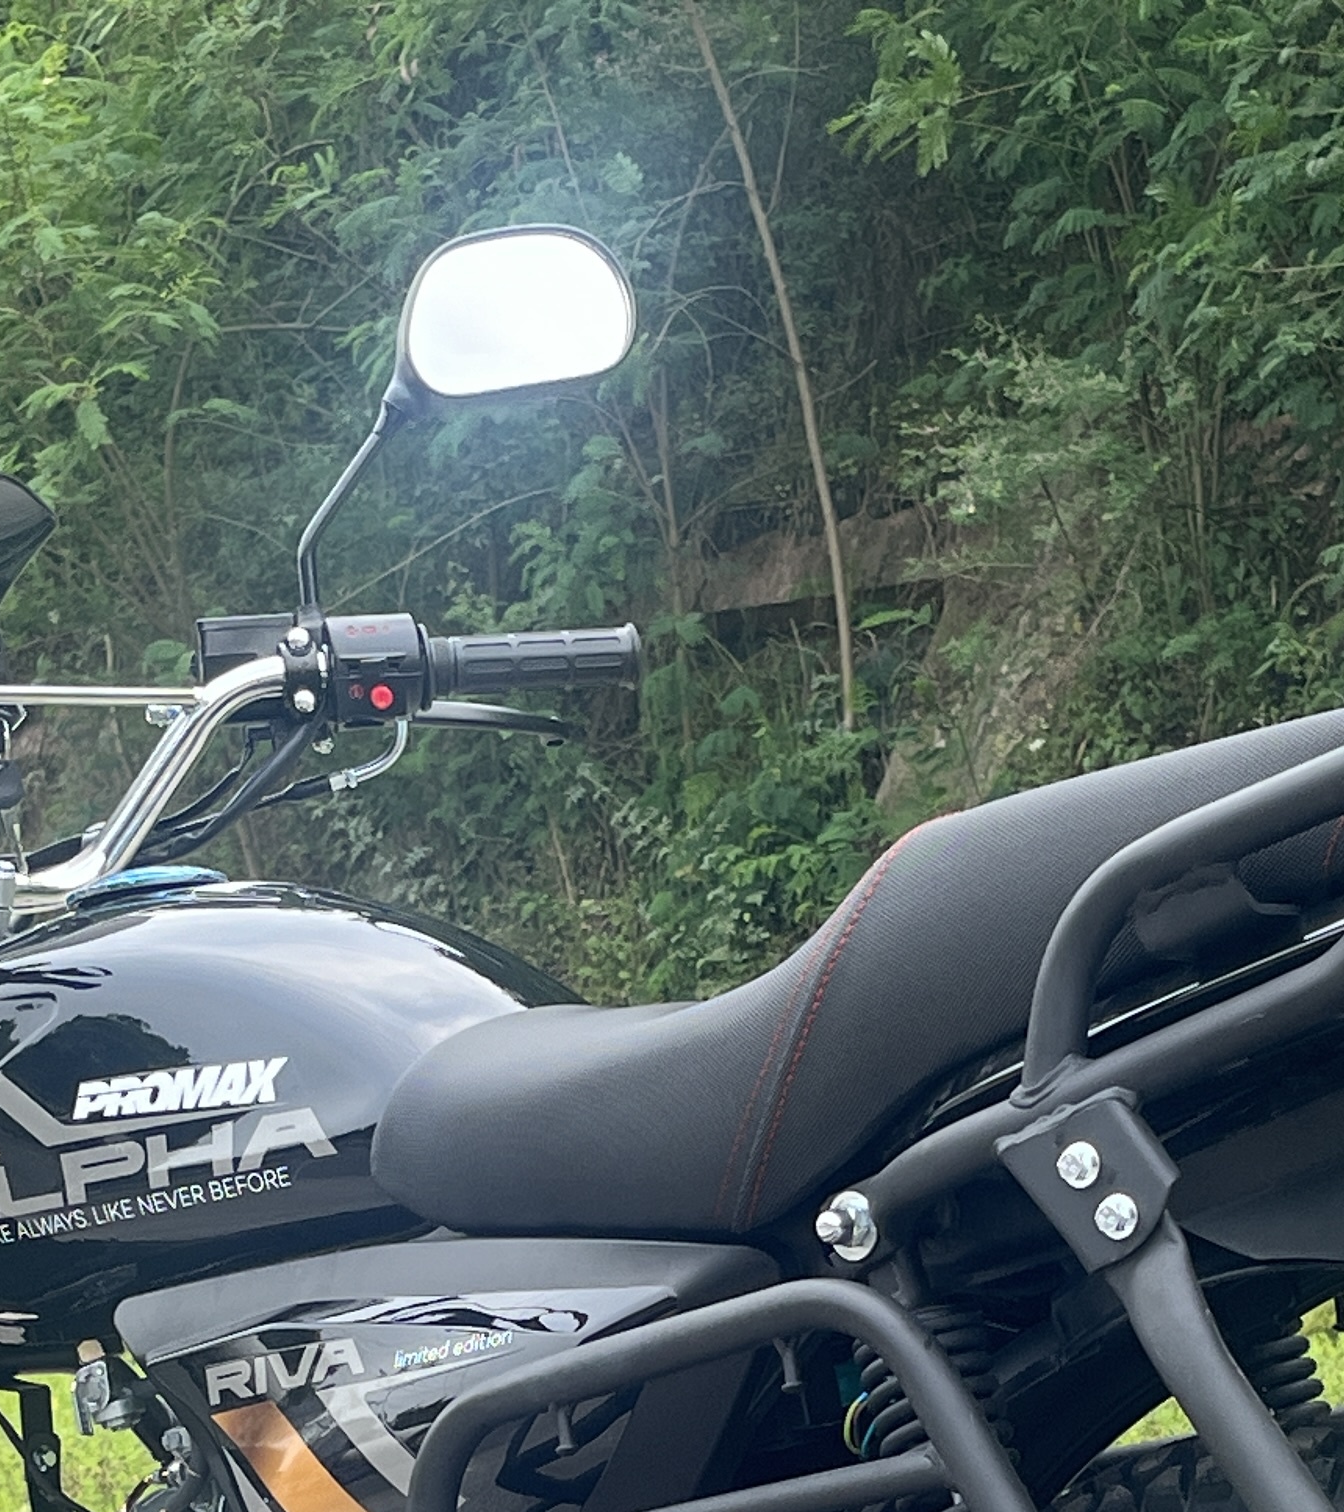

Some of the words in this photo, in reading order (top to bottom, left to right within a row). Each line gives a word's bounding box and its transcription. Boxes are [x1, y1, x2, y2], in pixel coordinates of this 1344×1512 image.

[72, 1056, 289, 1121] PROMAX
[93, 1197, 136, 1225] LIKE
[136, 1183, 207, 1216] NEVER
[208, 1165, 293, 1202] BEFORE
[205, 1338, 365, 1406] RIVA
[393, 1340, 450, 1369] limited
[452, 1329, 513, 1356] edition
